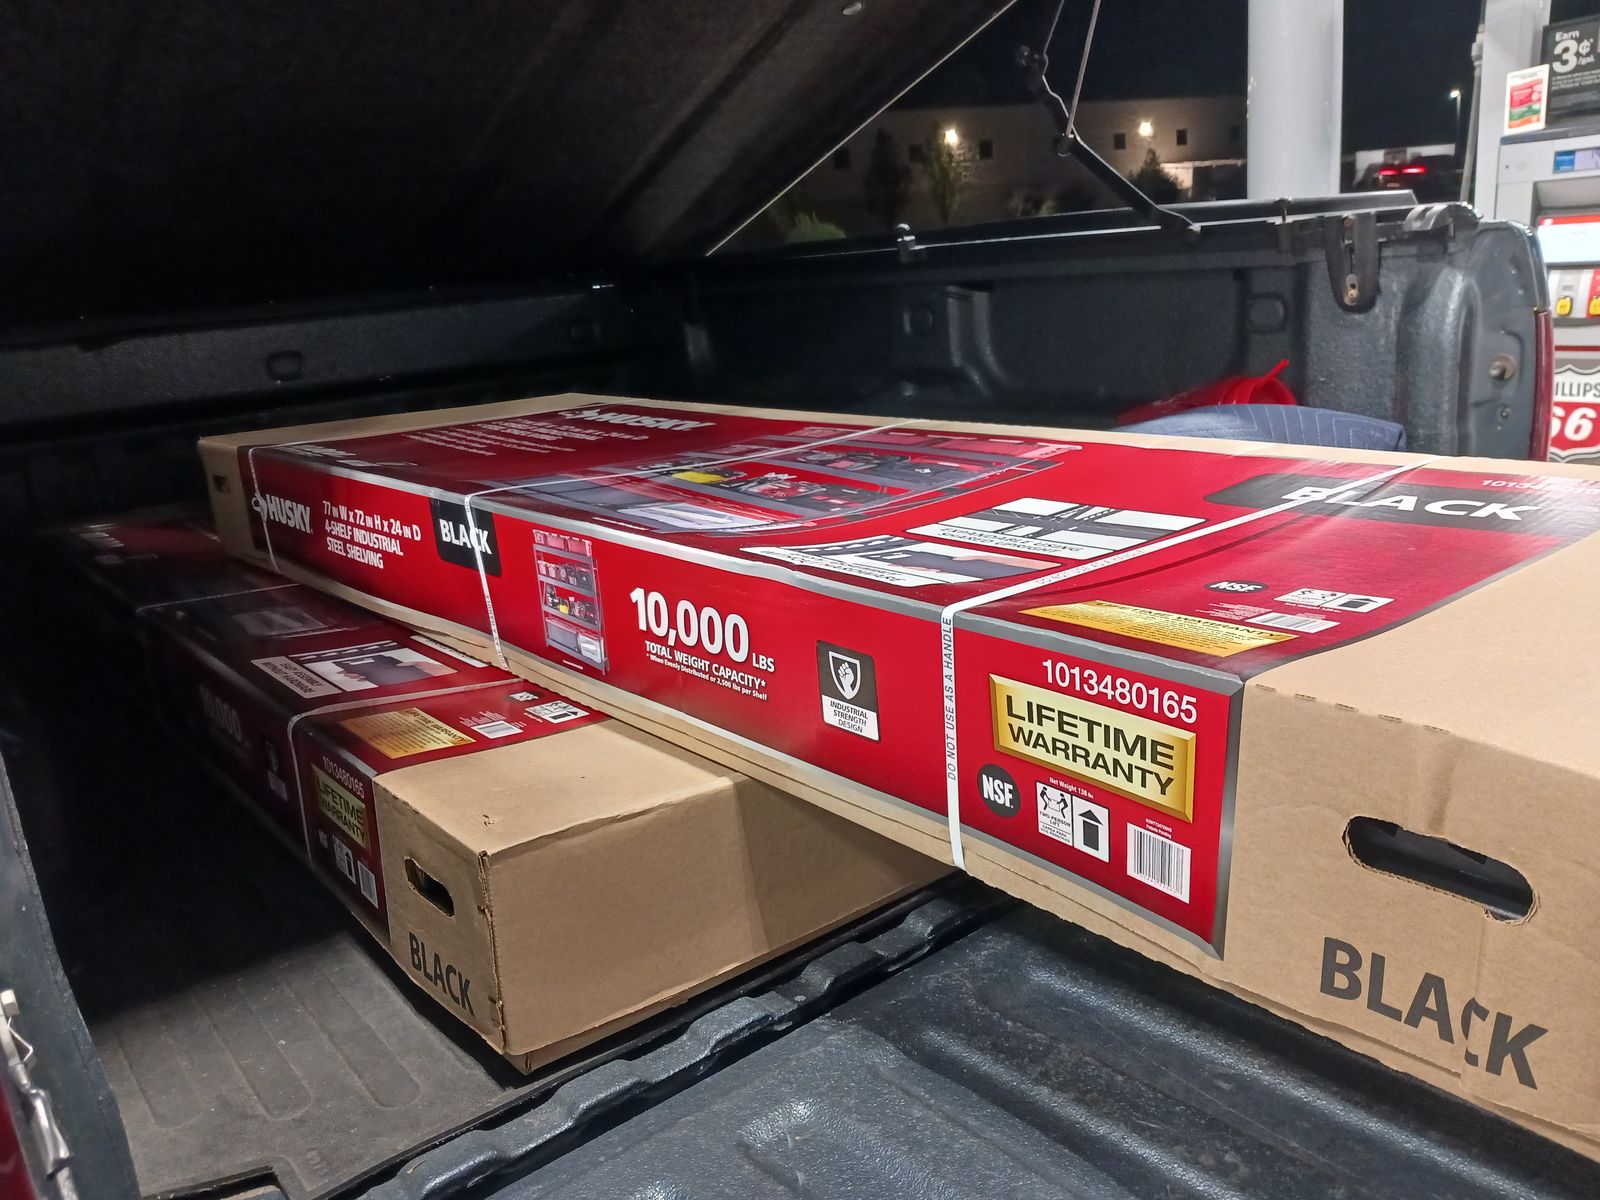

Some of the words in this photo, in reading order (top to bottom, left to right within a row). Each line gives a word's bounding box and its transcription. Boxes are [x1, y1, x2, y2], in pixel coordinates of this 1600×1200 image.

[1555, 30, 1579, 42] Earn
[1555, 382, 1600, 398] ILLIPS
[266, 494, 311, 534] HUSKY
[323, 500, 331, 516] 77
[339, 505, 347, 520] W
[355, 509, 365, 525] 72
[373, 514, 381, 531] H
[389, 518, 402, 536] 24
[402, 525, 412, 539] IN
[412, 524, 421, 542] D
[1281, 485, 1541, 521] BLACK
[325, 518, 352, 540] 4-SHELF
[353, 527, 404, 556] INDUSTRIAL
[327, 536, 346, 556] STEEL
[346, 543, 384, 569] SHELVING
[1210, 582, 1262, 592] NSF
[629, 587, 749, 663] 10,000
[752, 653, 775, 672] LBS
[943, 617, 952, 670] HANDLE
[645, 640, 672, 659] TOTAL
[674, 650, 710, 672] WEIGHT
[681, 663, 709, 681] Distributed
[752, 689, 768, 701] Shelf
[945, 674, 953, 683] A
[945, 686, 954, 703] AS
[1042, 659, 1198, 724] 1013480165
[830, 700, 869, 720] INDUSTRIAL
[833, 710, 867, 726] STRENGTH
[838, 719, 863, 733] DESIGN
[945, 707, 955, 730] USE
[946, 734, 955, 760] NOT
[1006, 695, 1175, 771] LIFETIME
[947, 763, 956, 781] DO
[1008, 722, 1174, 796] WARRANTY
[317, 776, 364, 826] LIFETIME
[320, 793, 366, 843] WARRANTY
[409, 931, 475, 1018] BLACK
[1320, 936, 1549, 1090] BLACK
